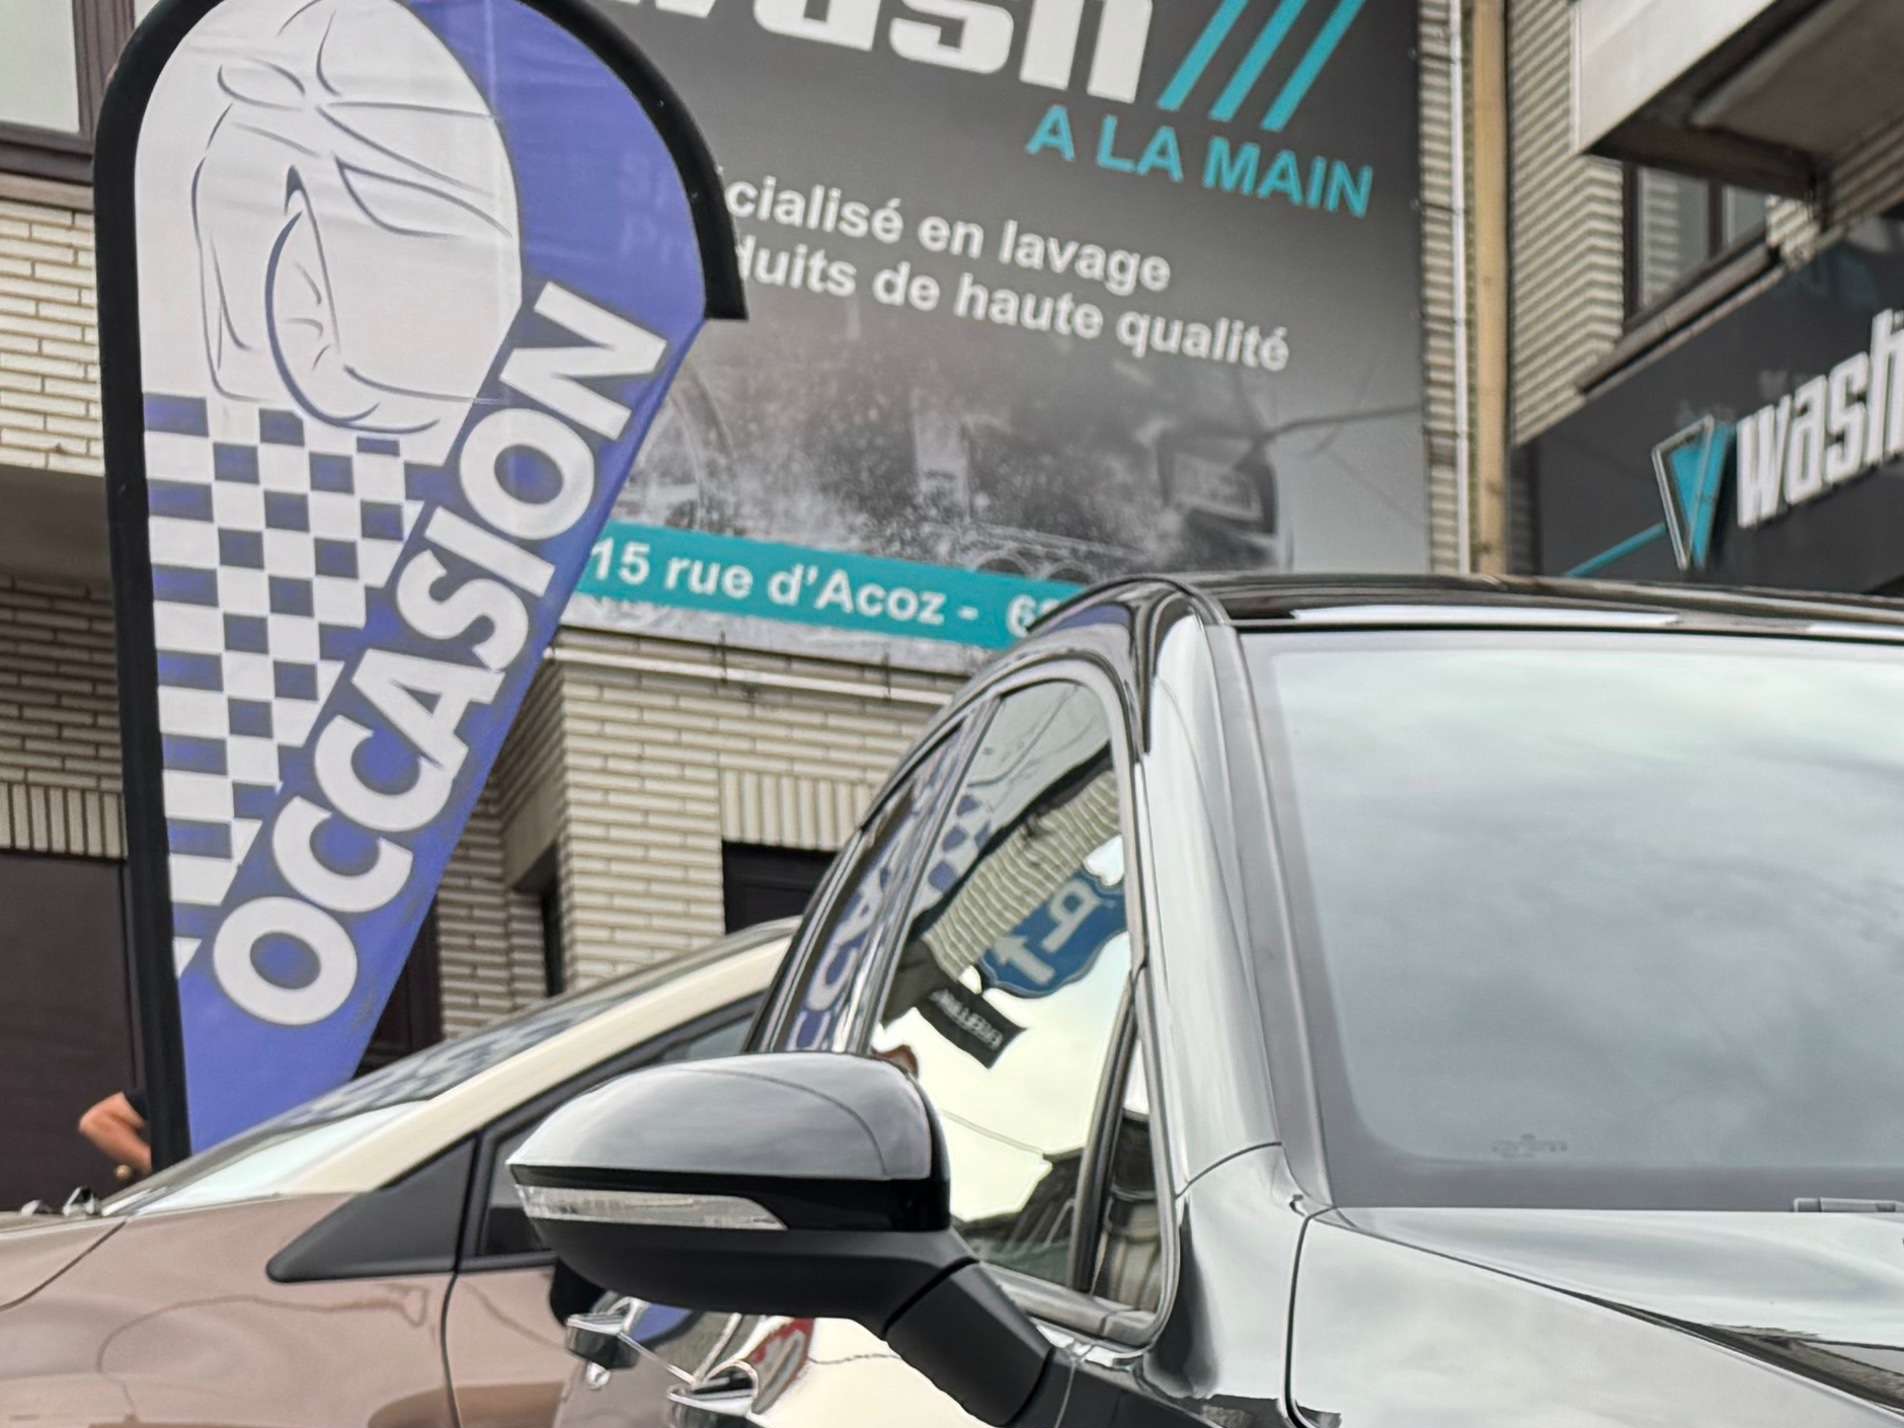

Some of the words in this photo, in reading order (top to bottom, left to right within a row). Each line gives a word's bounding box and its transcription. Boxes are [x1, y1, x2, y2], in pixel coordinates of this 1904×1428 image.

[573, 0, 1153, 103] ash
[1025, 105, 1076, 160] A
[1097, 116, 1184, 183] LA
[1202, 136, 1375, 219] MAIN
[725, 176, 904, 244] cialisé
[918, 214, 985, 260] en
[998, 220, 1172, 297] lavage
[872, 262, 941, 312] de
[953, 273, 1104, 340] haute
[1115, 310, 1291, 372] qualité
[665, 556, 754, 599] rue
[768, 563, 946, 627] d'Acoz
[213, 284, 668, 1027] OCCASION
